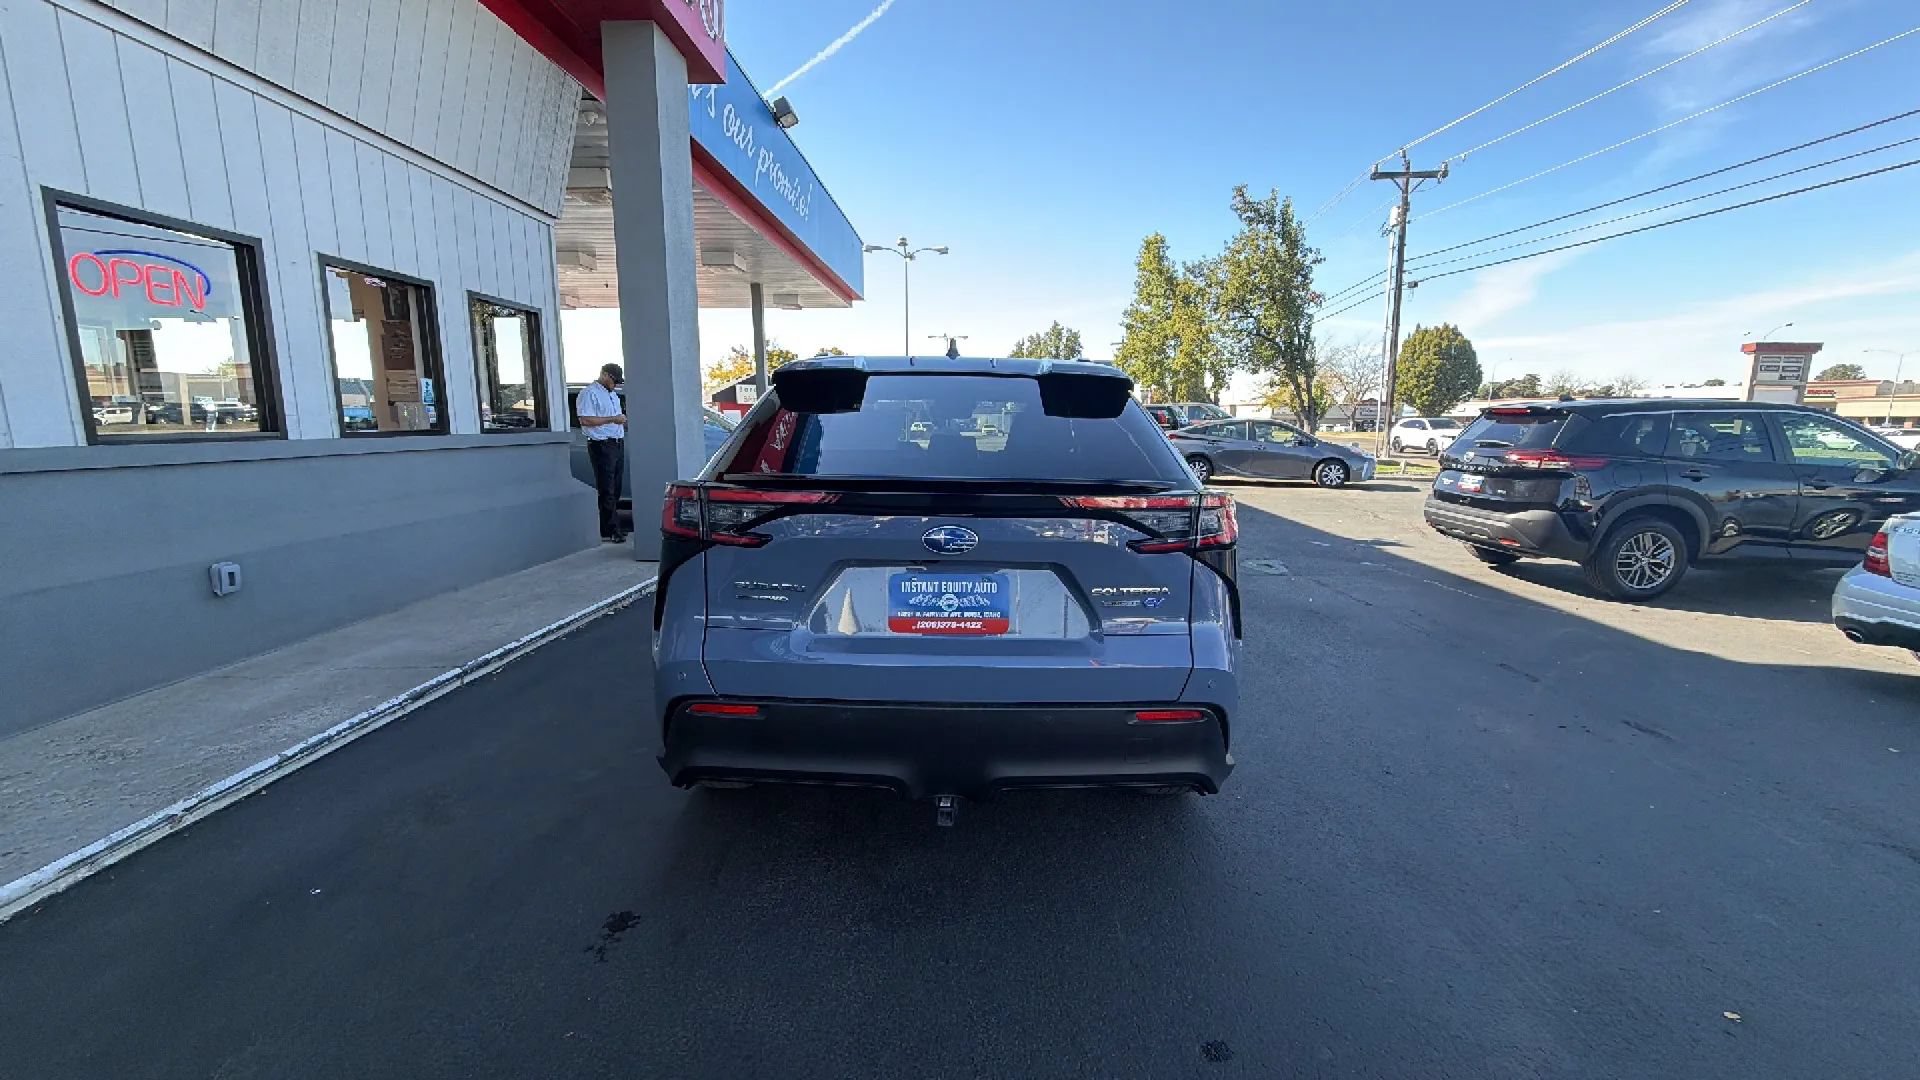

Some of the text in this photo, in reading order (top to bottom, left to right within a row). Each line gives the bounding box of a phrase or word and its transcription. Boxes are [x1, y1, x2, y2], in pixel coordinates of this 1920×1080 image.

[68, 252, 206, 310] OPEN
[901, 581, 998, 593] INSTANT EQUITY AUTO
